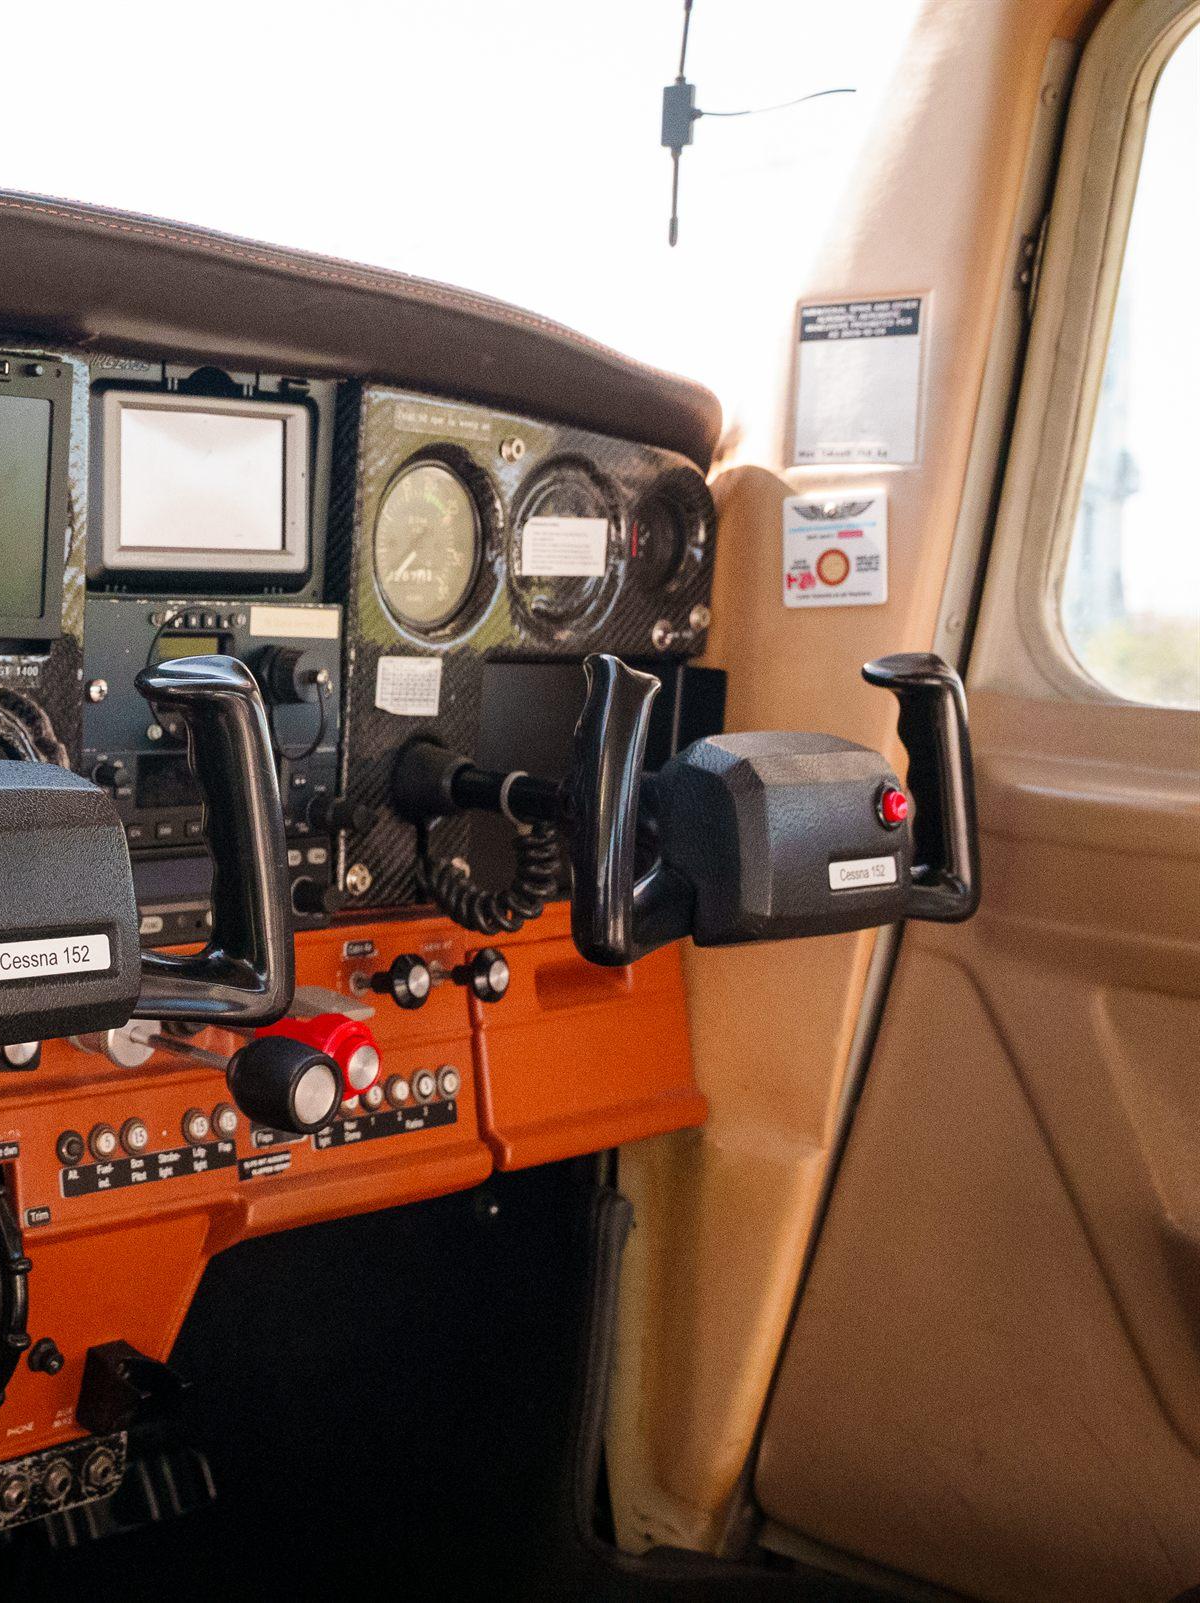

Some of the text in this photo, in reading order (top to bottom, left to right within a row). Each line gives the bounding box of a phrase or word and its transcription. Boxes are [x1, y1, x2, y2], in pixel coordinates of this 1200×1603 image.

[840, 864, 886, 882] Cessna 152
[0, 944, 91, 971] Cessna 152
